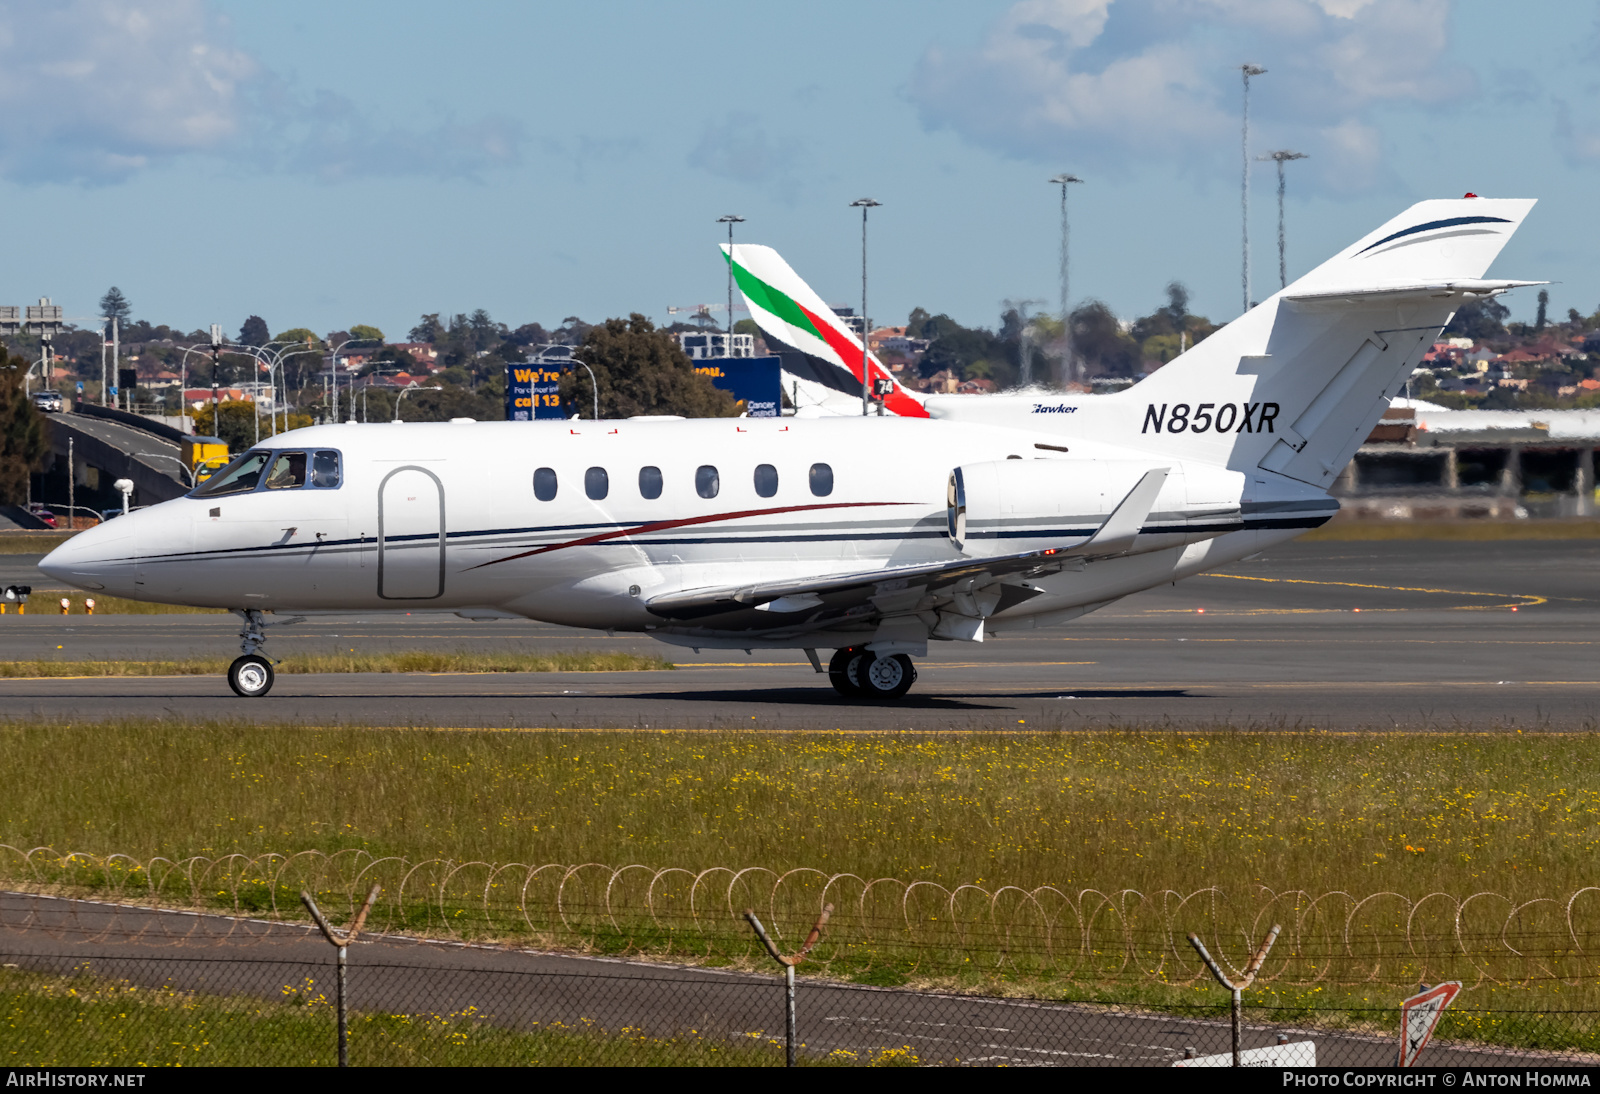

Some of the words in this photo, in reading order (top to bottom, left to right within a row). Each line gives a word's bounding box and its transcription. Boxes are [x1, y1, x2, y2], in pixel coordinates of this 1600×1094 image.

[514, 368, 560, 383] We're
[526, 386, 548, 394] cncer
[879, 380, 893, 394] 74
[514, 394, 540, 407] cal
[542, 394, 560, 407] 13
[747, 401, 776, 409] Cancer
[1141, 402, 1280, 433] N850XR
